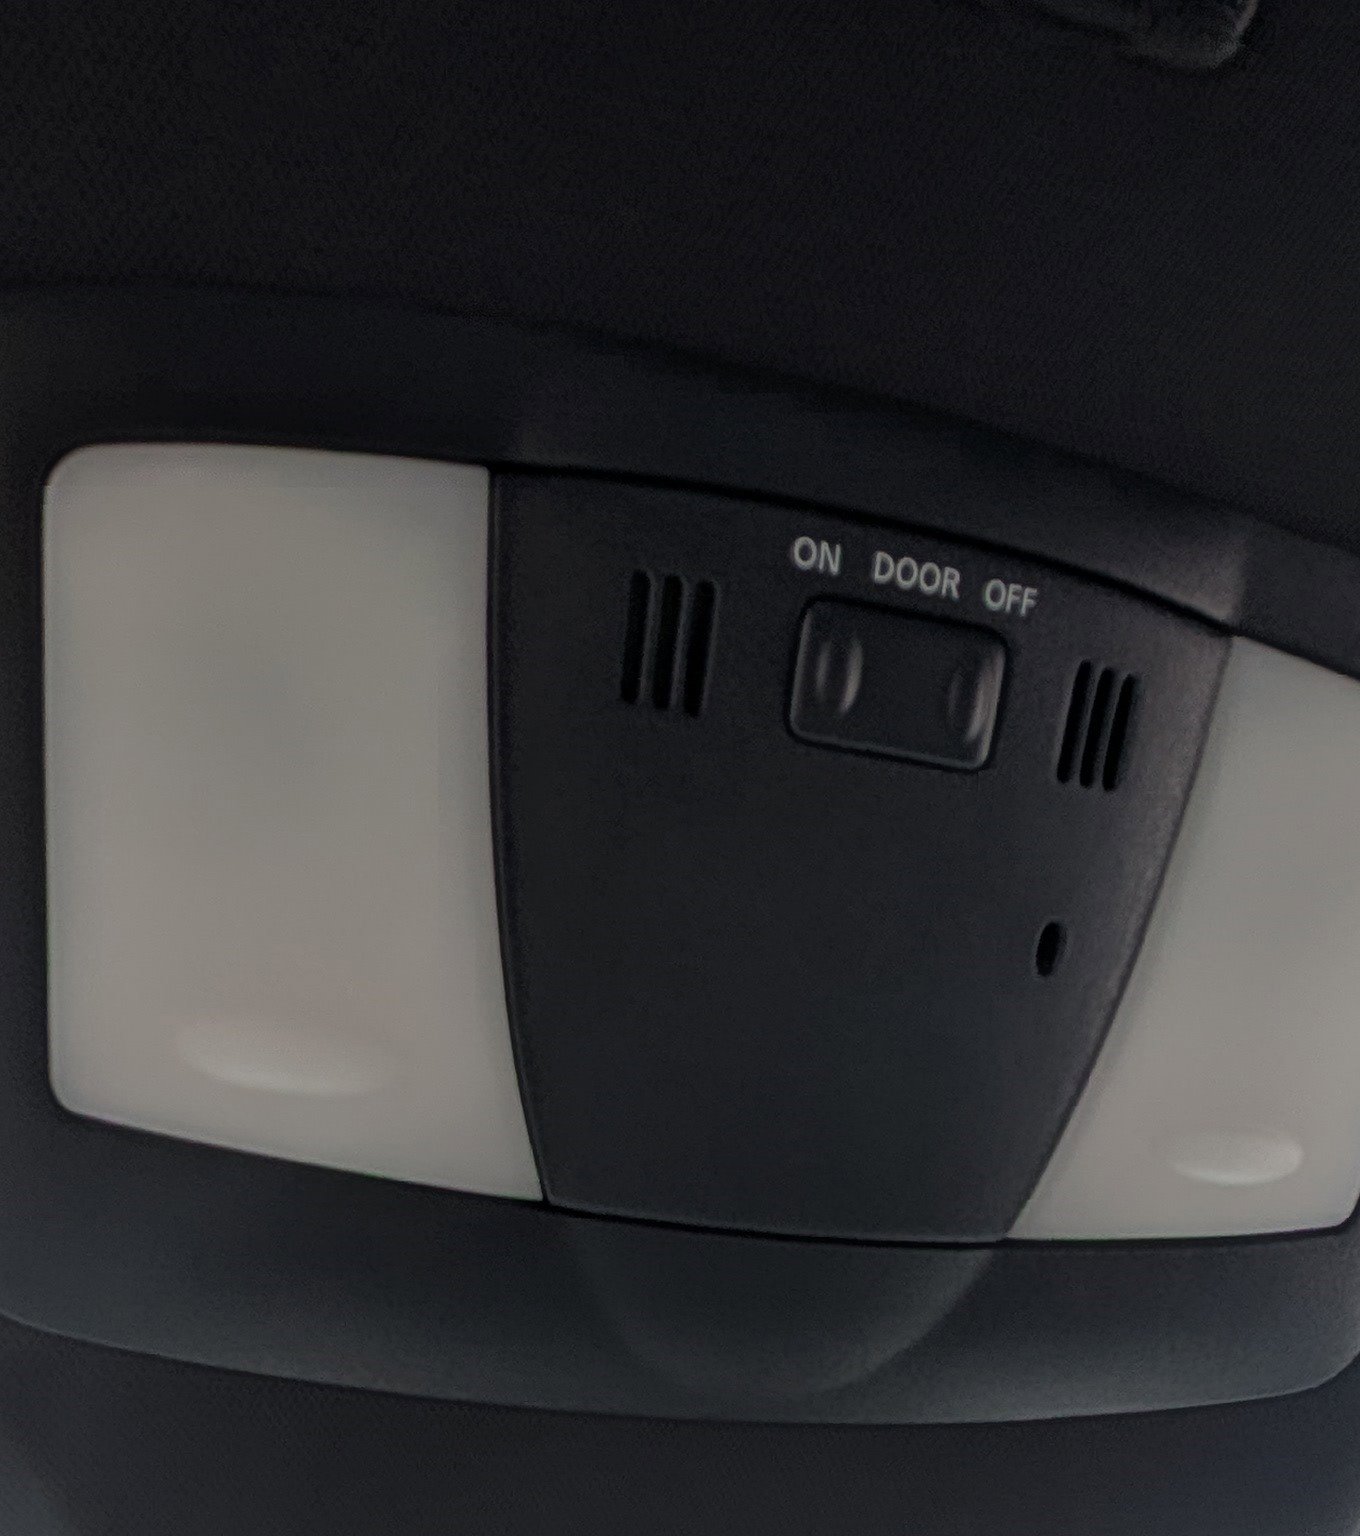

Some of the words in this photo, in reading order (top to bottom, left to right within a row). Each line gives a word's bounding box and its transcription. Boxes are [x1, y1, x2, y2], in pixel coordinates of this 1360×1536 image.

[792, 536, 841, 576] ON
[872, 551, 961, 600] DOOR
[984, 578, 1038, 617] OFF
